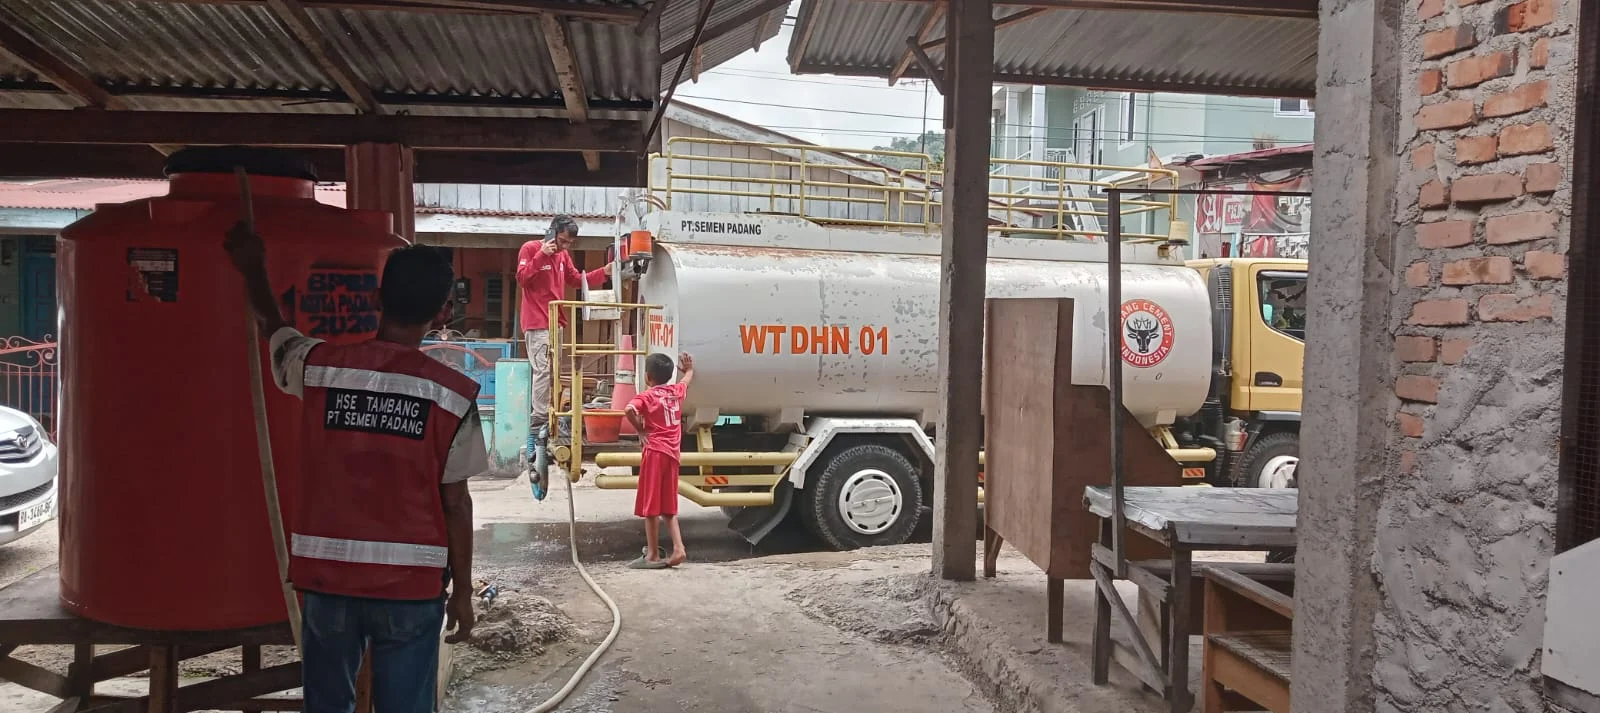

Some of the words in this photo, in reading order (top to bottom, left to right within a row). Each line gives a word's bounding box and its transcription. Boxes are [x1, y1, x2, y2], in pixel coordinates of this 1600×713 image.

[681, 220, 725, 233] PT.SEMEN
[727, 222, 762, 235] PADANG
[1120, 302, 1139, 323] ANG
[1143, 302, 1172, 337] CEMENT
[650, 323, 674, 348] WT-01
[739, 325, 787, 354] WT
[791, 326, 850, 354] DHN
[859, 326, 888, 355] 01
[1121, 345, 1168, 365] INDONESIA
[336, 393, 358, 410] HSE
[366, 396, 420, 418] TAMBANG
[327, 411, 340, 424] PT
[344, 411, 378, 428] SEMEN
[380, 415, 424, 435] PADANG
